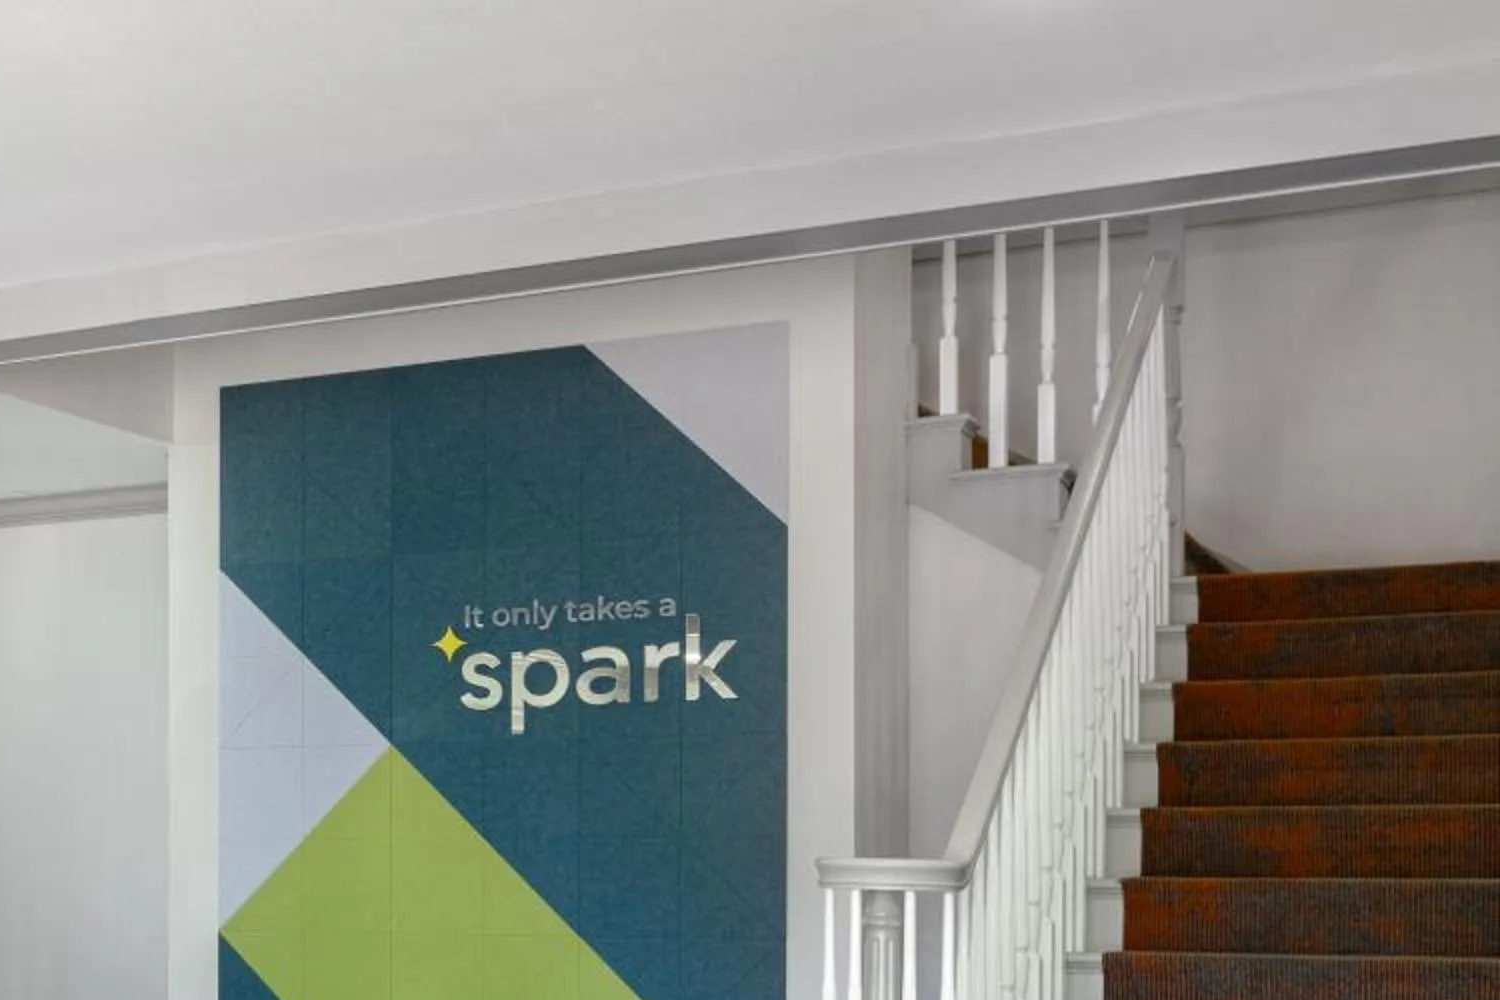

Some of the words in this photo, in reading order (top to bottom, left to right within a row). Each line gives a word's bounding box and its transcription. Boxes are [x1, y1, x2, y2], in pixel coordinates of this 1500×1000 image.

[463, 604, 485, 629] It
[492, 600, 559, 630] only
[564, 594, 651, 624] takes
[657, 597, 678, 618] a
[459, 613, 739, 735] spark
